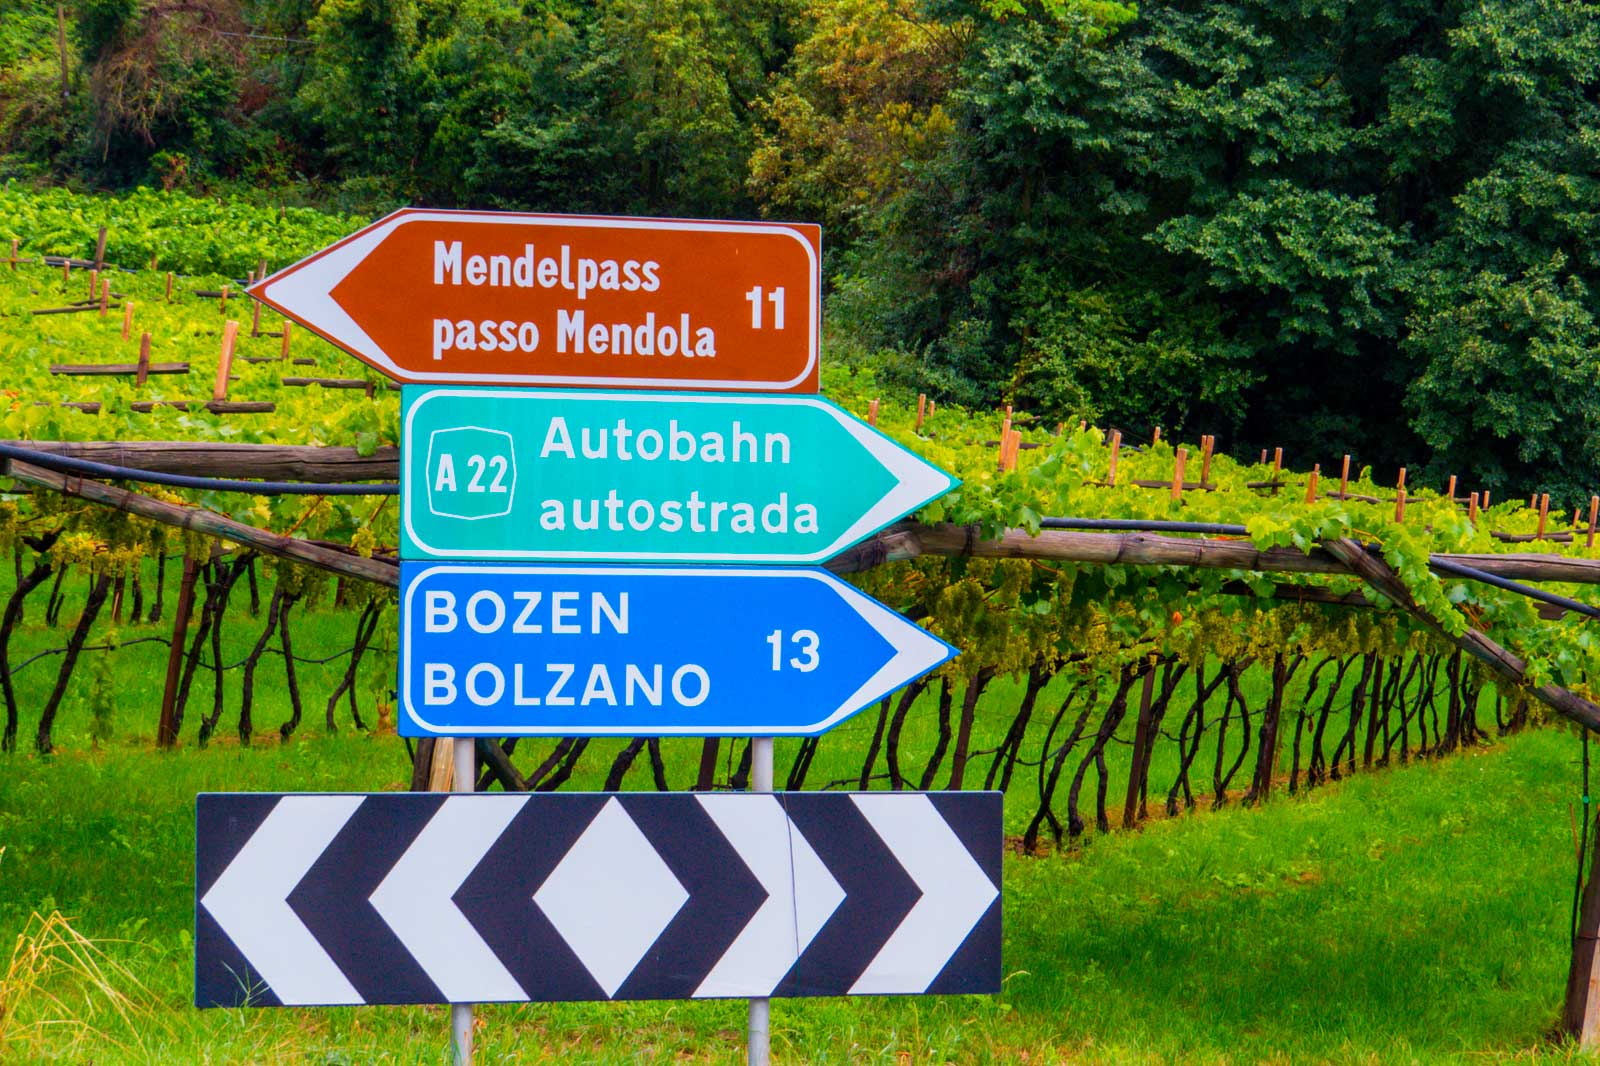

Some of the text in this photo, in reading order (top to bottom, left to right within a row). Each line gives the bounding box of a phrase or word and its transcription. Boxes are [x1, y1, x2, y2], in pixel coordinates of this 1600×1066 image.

[433, 240, 661, 299] Mendelpass
[745, 285, 785, 330] 11
[432, 308, 717, 361] passo Mendola
[540, 416, 791, 464] Autobahn
[434, 453, 508, 493] A 22
[539, 489, 819, 534] autostrada
[425, 589, 629, 634] BOZEN
[766, 629, 820, 673] 13
[424, 662, 711, 707] BOLZANO
